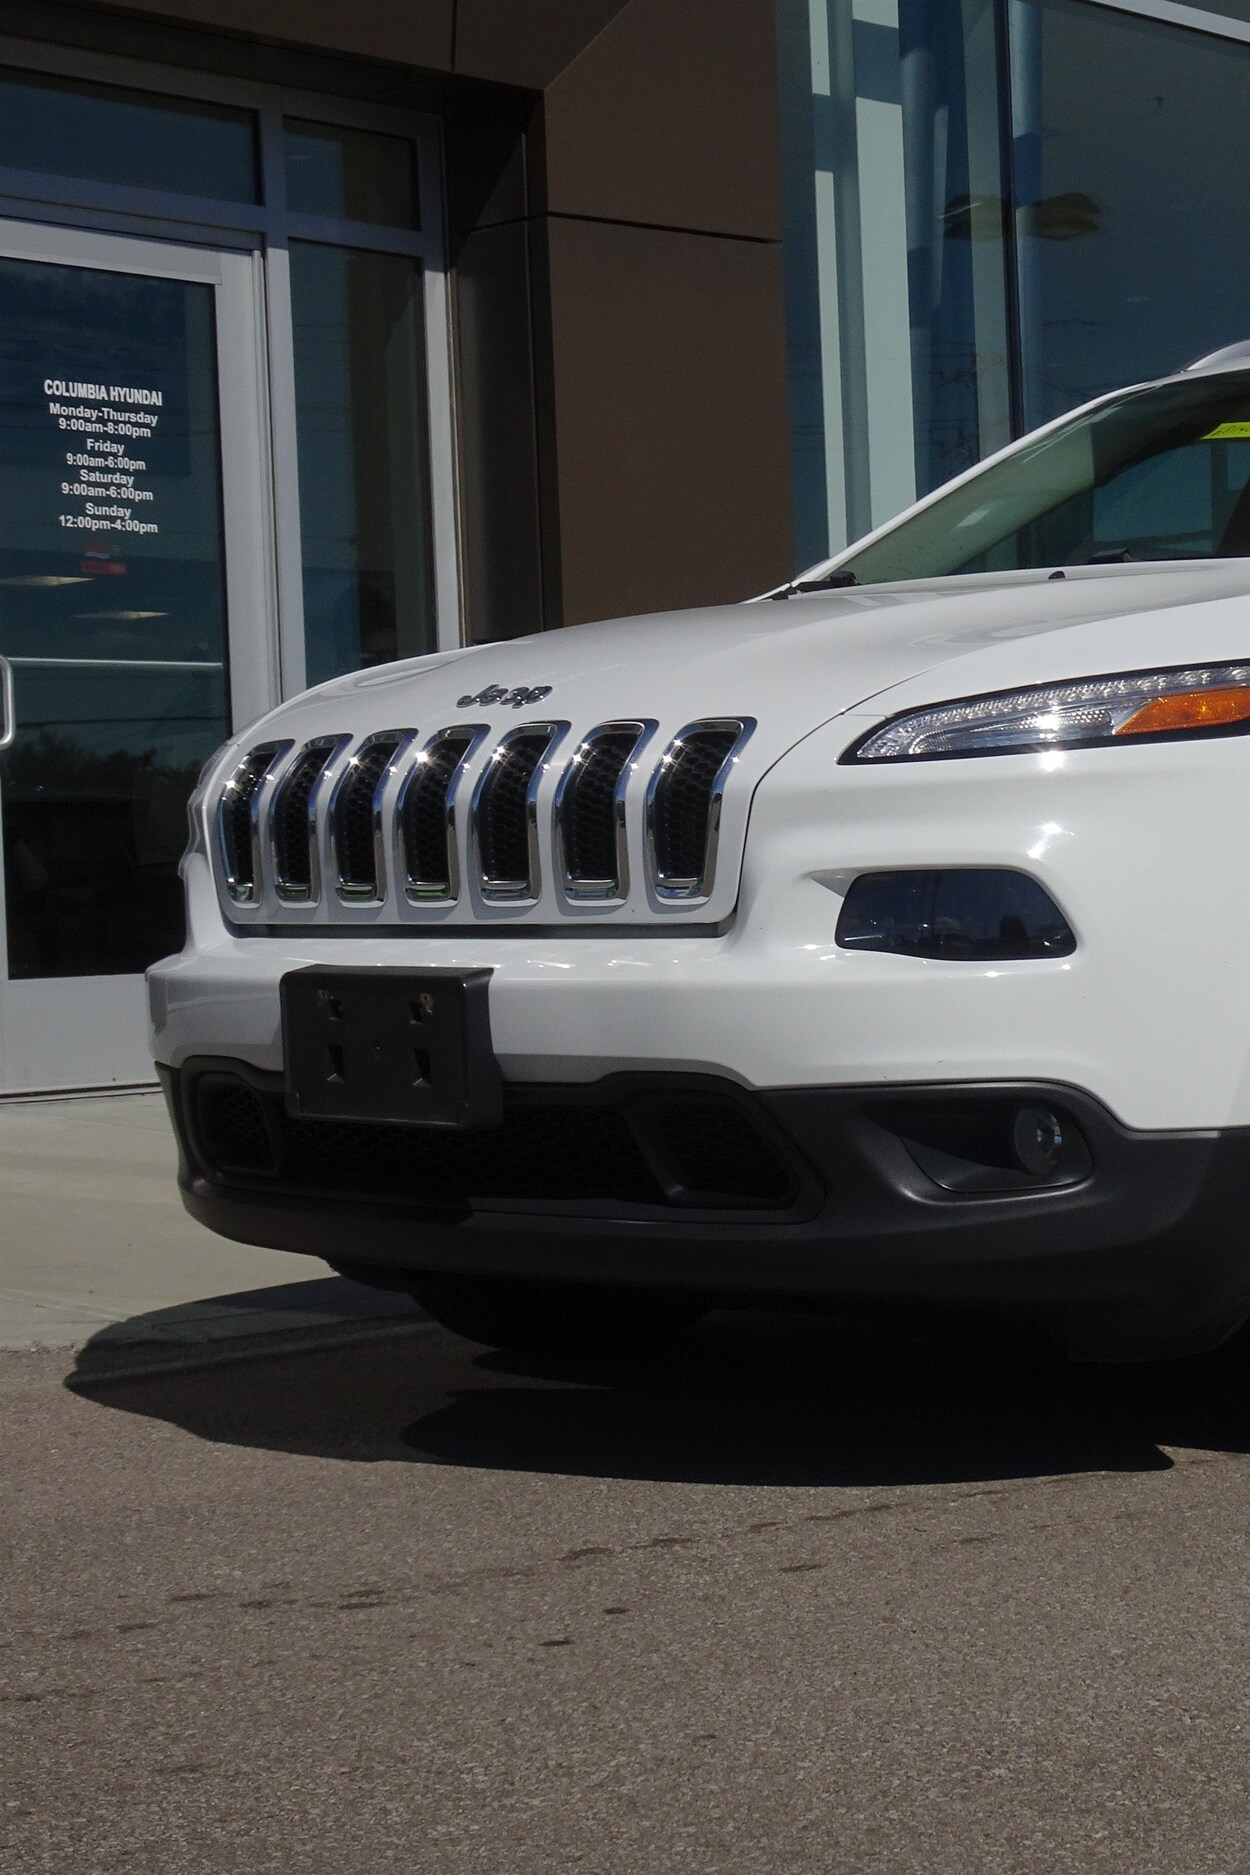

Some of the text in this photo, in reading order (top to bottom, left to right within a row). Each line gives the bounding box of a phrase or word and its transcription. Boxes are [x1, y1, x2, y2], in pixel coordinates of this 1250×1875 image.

[44, 379, 162, 406] COLUMBIA HYUNDAI
[49, 403, 158, 427] Monday-Thursday
[58, 418, 151, 438] 9:00am-8:00pm
[87, 439, 125, 455] Friday
[66, 453, 146, 472] 9:00am-6:00pm
[80, 470, 134, 487] Saturday
[61, 482, 154, 502] 9:00am-6:00pm
[85, 503, 131, 519] Sunday
[59, 515, 158, 535] 12:00pm-4:00pm
[456, 684, 553, 709] Jeep
